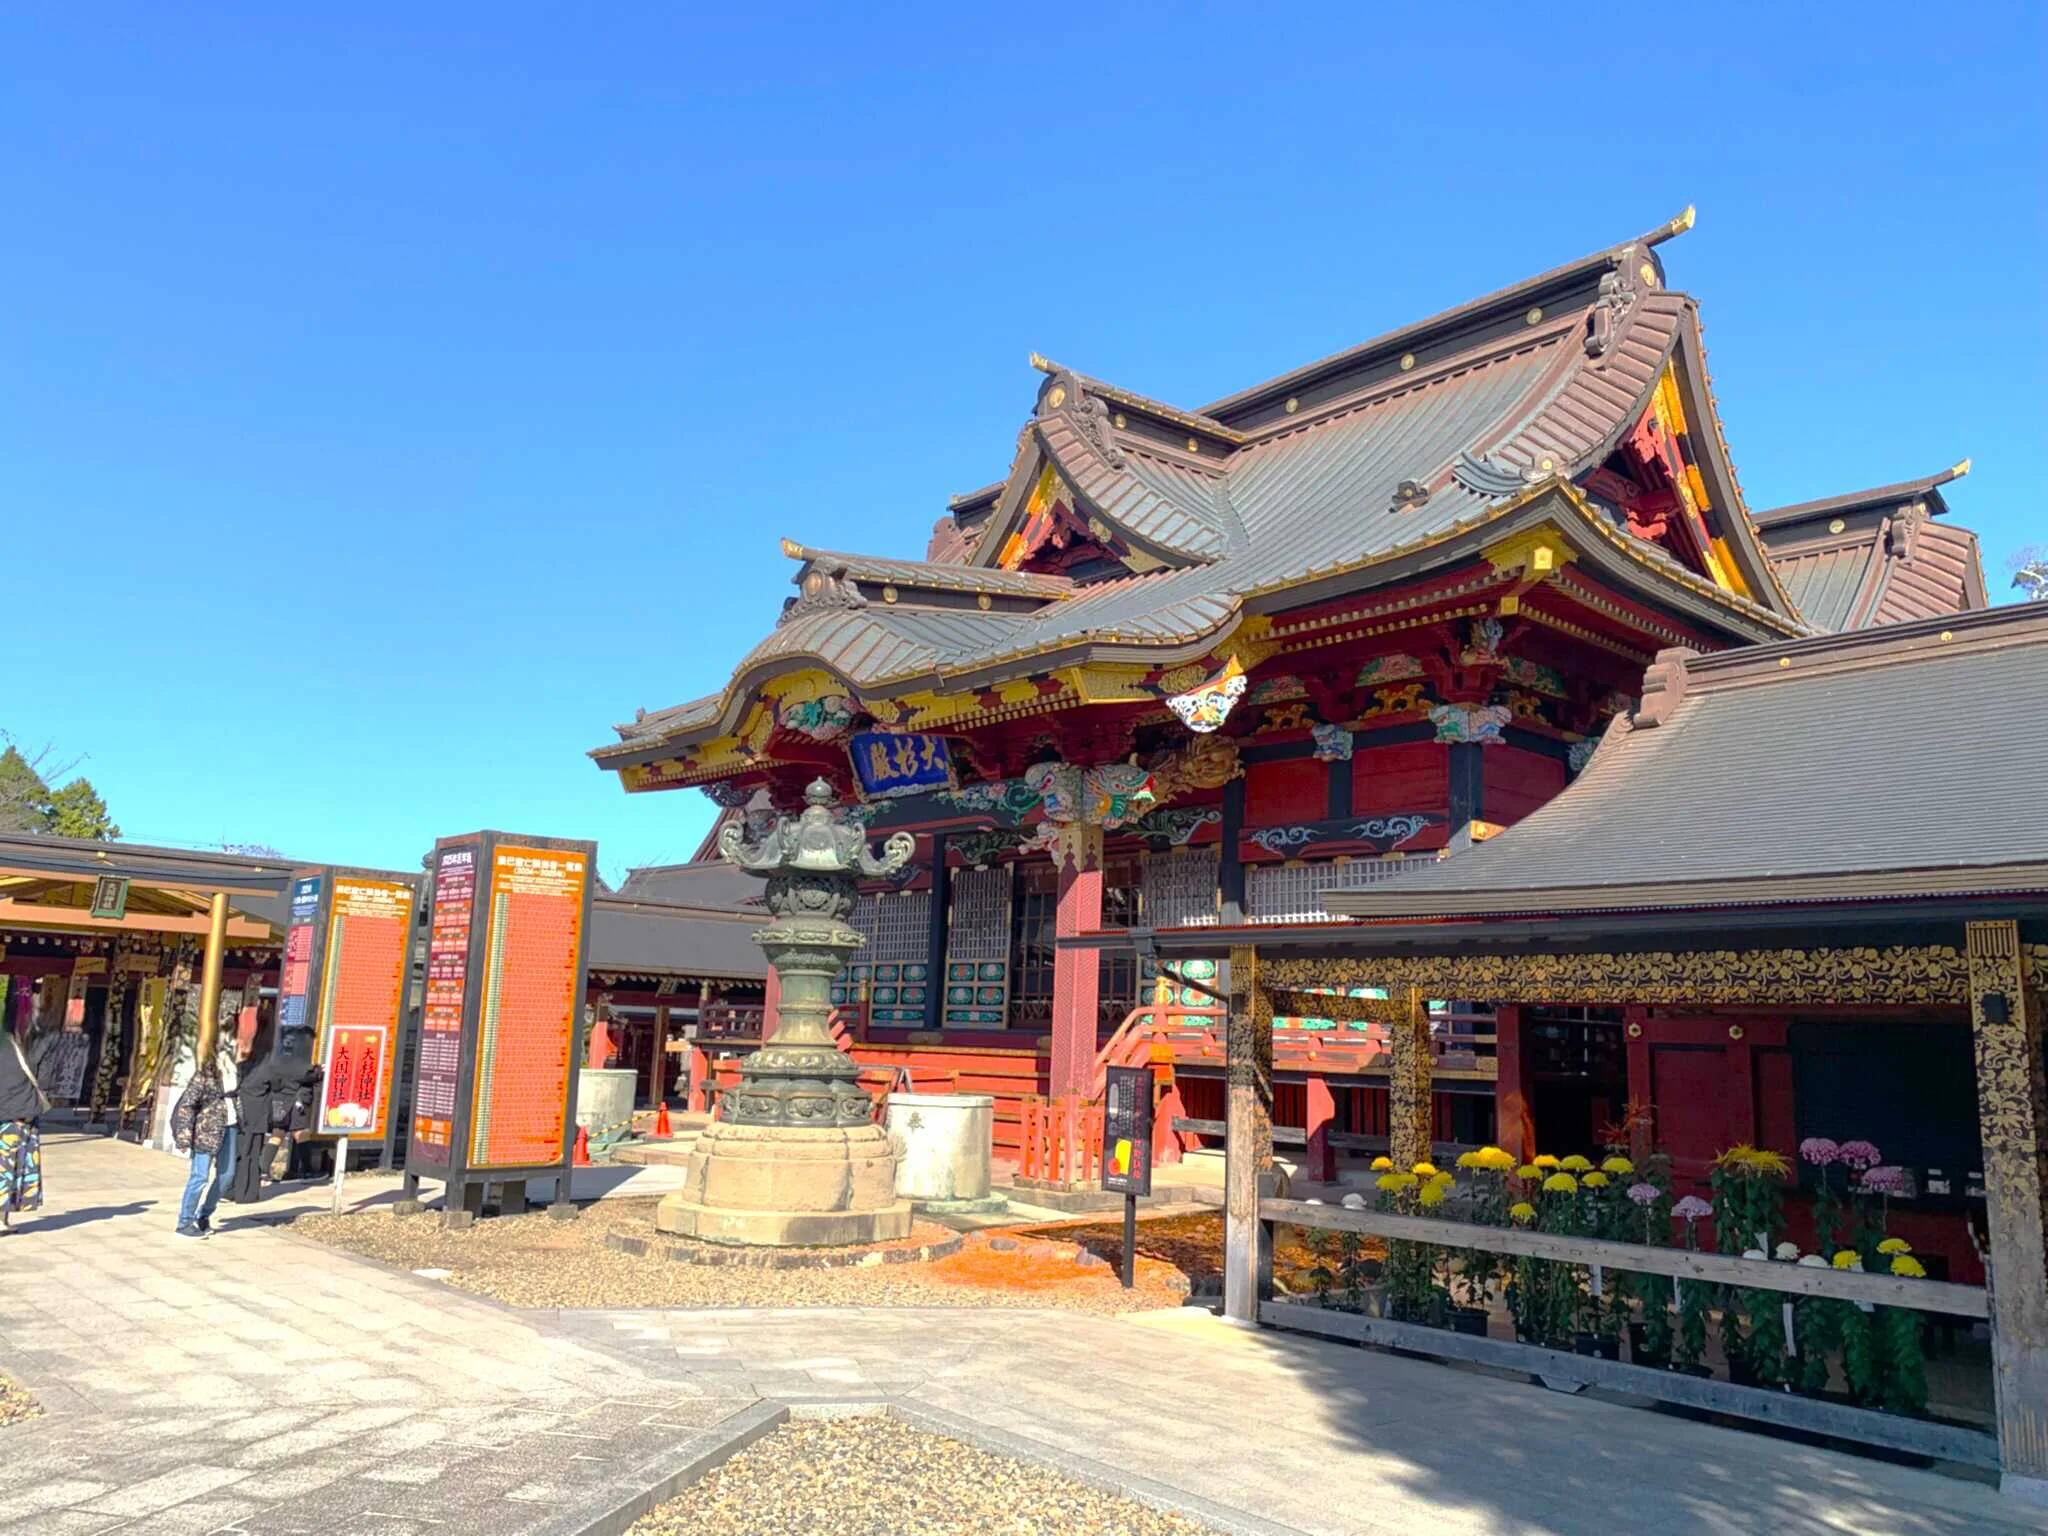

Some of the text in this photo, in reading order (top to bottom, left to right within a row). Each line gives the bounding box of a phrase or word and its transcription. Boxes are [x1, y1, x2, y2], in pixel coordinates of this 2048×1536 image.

[332, 1046, 350, 1102] 大国神社
[357, 1047, 376, 1102] 大杉神社
